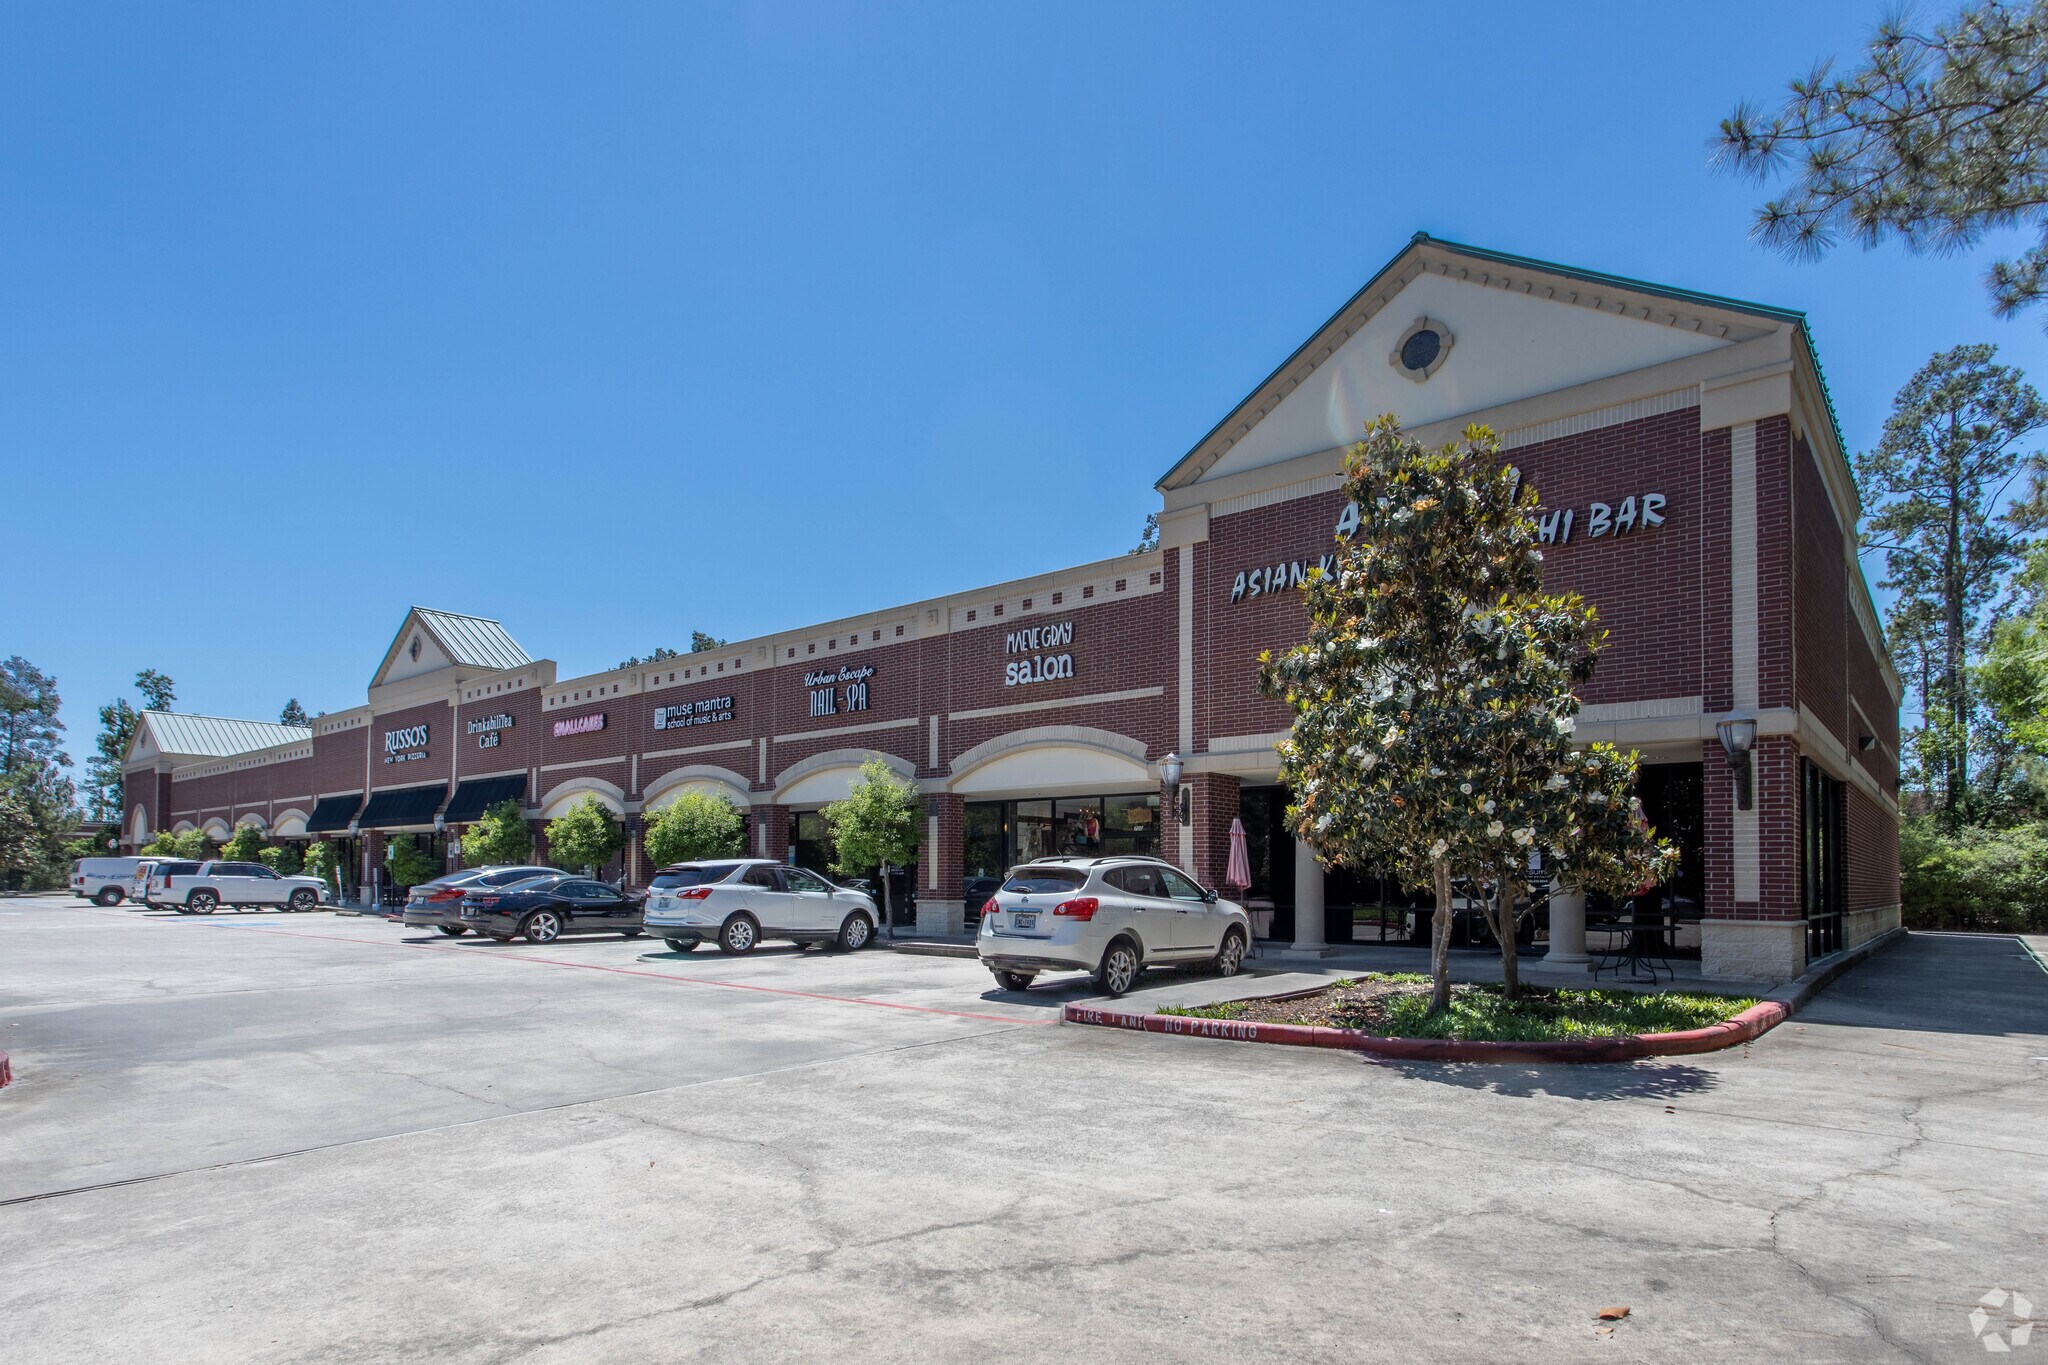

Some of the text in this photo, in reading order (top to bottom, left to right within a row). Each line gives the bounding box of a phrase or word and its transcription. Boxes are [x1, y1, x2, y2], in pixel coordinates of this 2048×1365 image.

[1588, 492, 1666, 538] BAR
[1230, 559, 1307, 604] ASIAN
[1006, 621, 1072, 654] MAEVE GRAY
[804, 665, 874, 687] Urban Escape
[1005, 653, 1073, 686] salon
[667, 696, 731, 718] muse mantra
[810, 687, 836, 717] NAIL
[846, 682, 867, 713] SPA
[467, 714, 513, 735] DrinkabiliTea
[667, 711, 732, 729] school of music & arts
[384, 724, 428, 755] RUSSO'S
[478, 731, 499, 749] Café
[384, 751, 427, 764] NEW YORK PIZZERIA
[1076, 1009, 1102, 1024] FIRE
[1165, 1018, 1182, 1033] NO
[1190, 1019, 1258, 1039] PARKING
